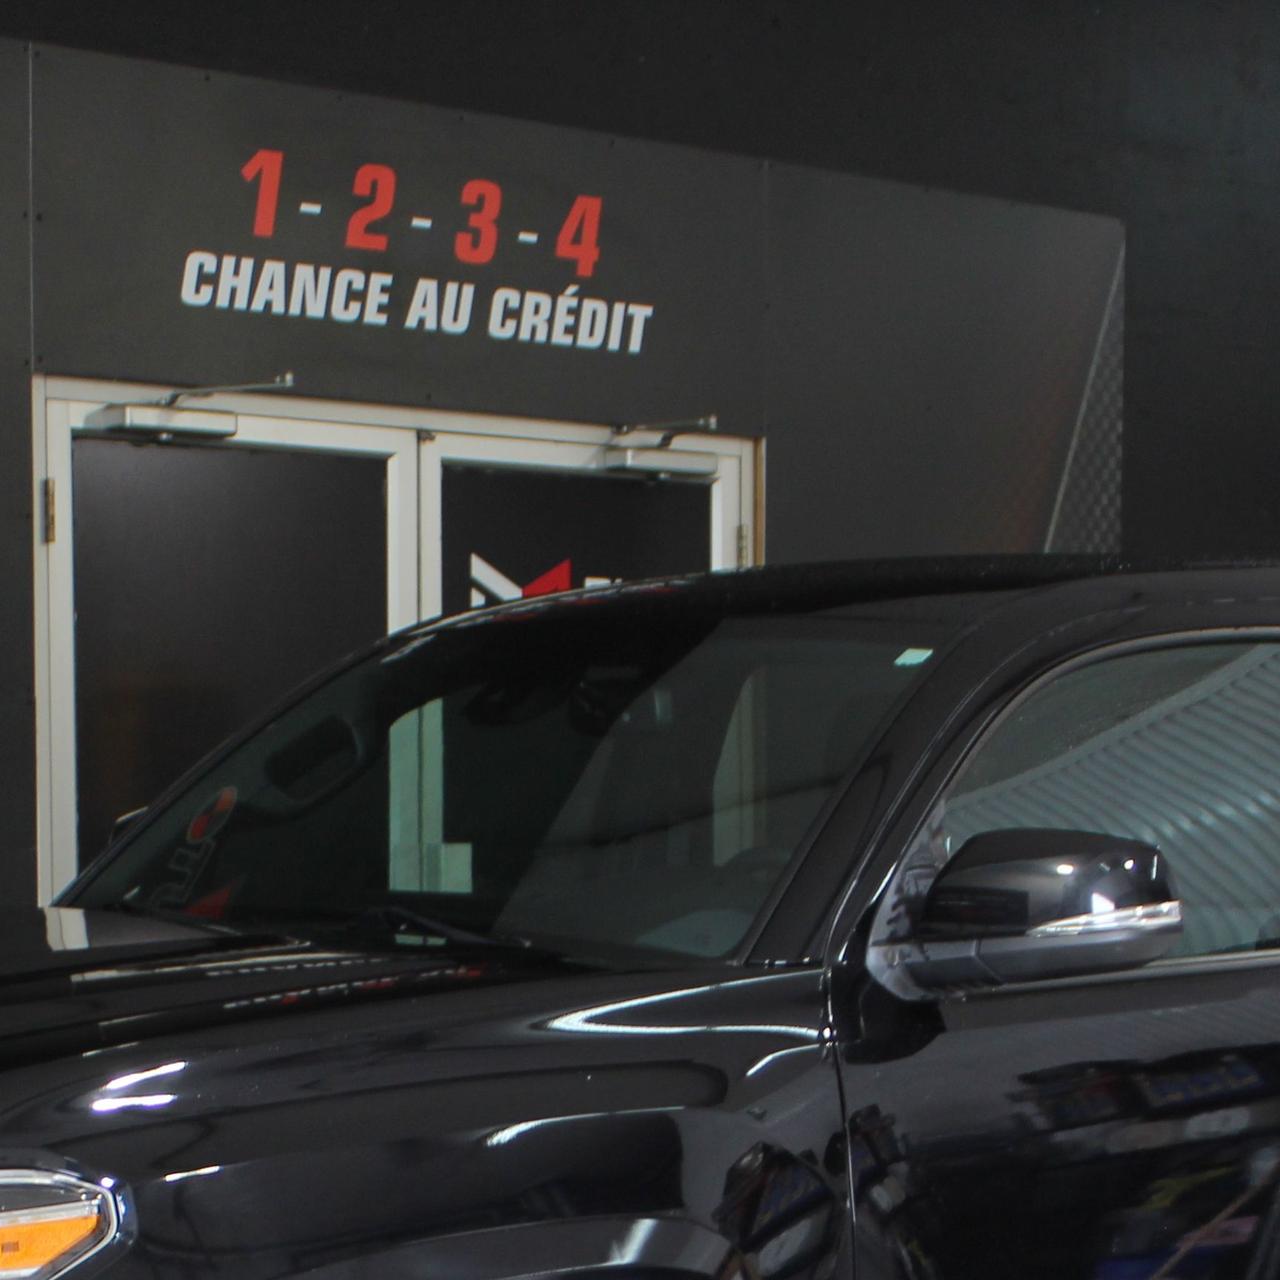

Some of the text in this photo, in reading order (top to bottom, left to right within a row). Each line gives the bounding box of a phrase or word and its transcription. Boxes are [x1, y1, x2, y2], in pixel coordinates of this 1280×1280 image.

[181, 252, 653, 354] CHANCE AU CRÉDIT
